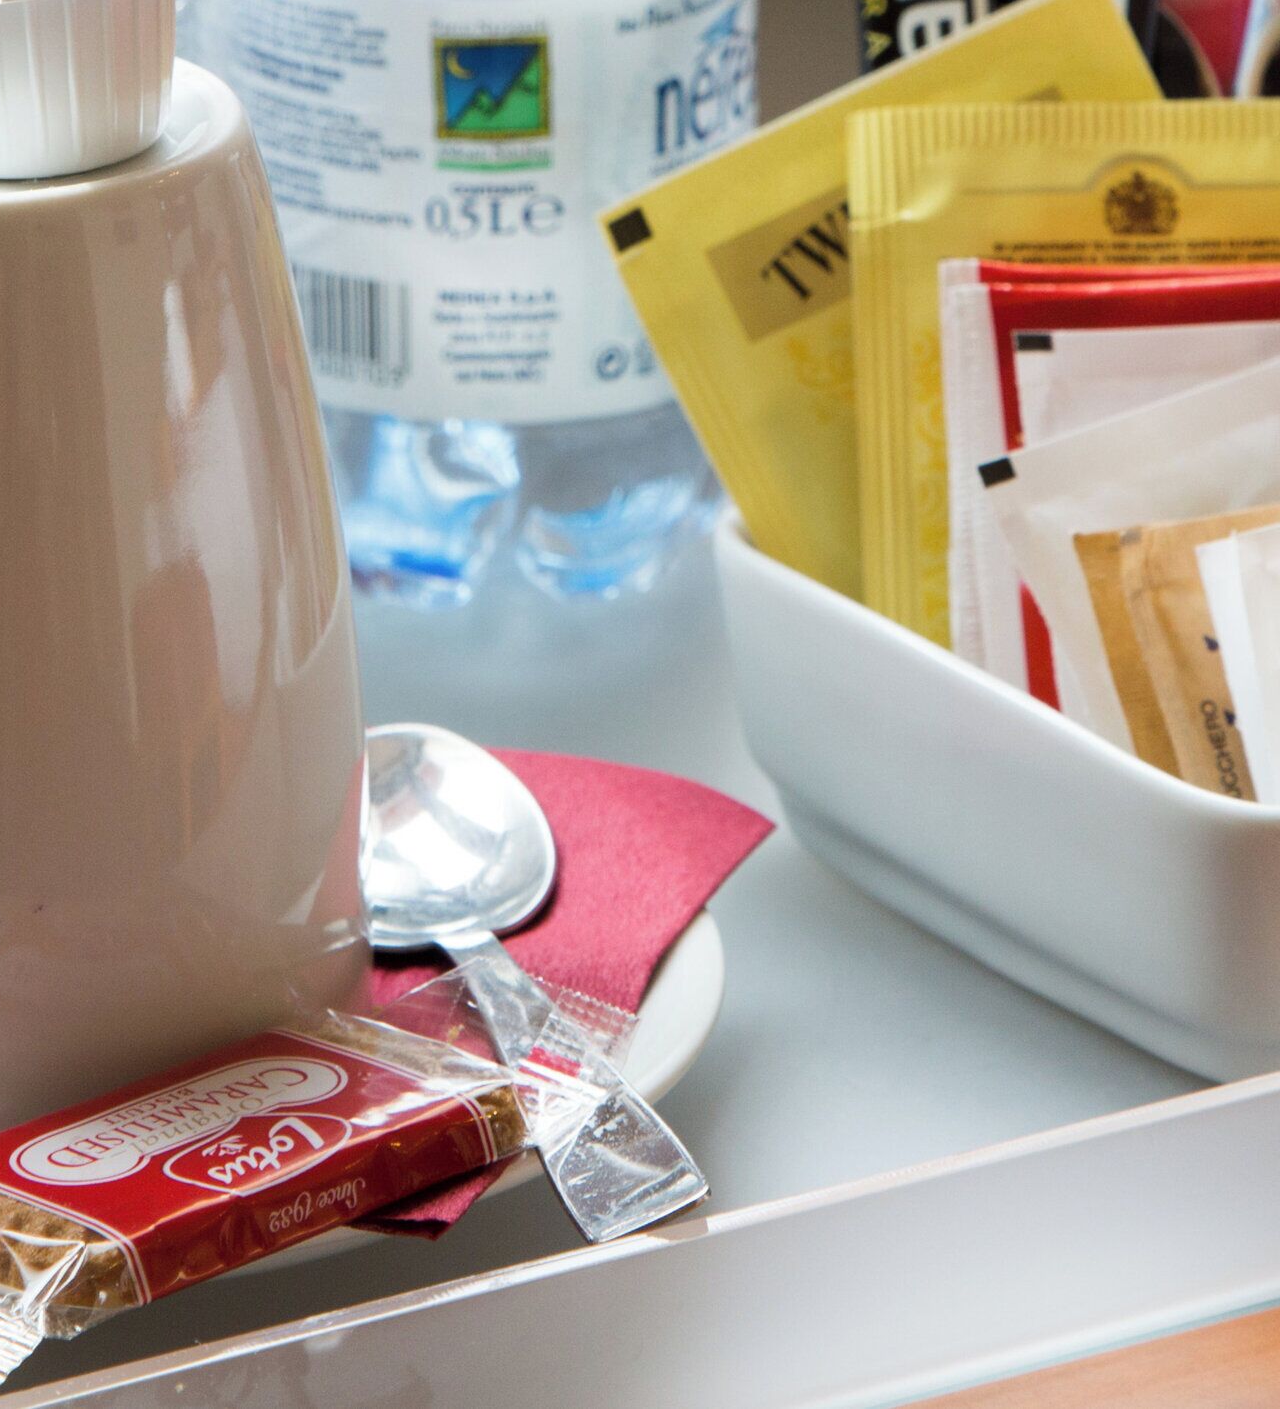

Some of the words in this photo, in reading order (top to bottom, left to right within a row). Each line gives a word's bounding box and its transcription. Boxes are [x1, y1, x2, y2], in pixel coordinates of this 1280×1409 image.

[47, 1067, 309, 1168] CARAMELISED
[130, 1096, 263, 1154] Original
[207, 1116, 325, 1185] Lotus
[269, 1191, 316, 1234] 1932
[316, 1177, 366, 1210] Since
